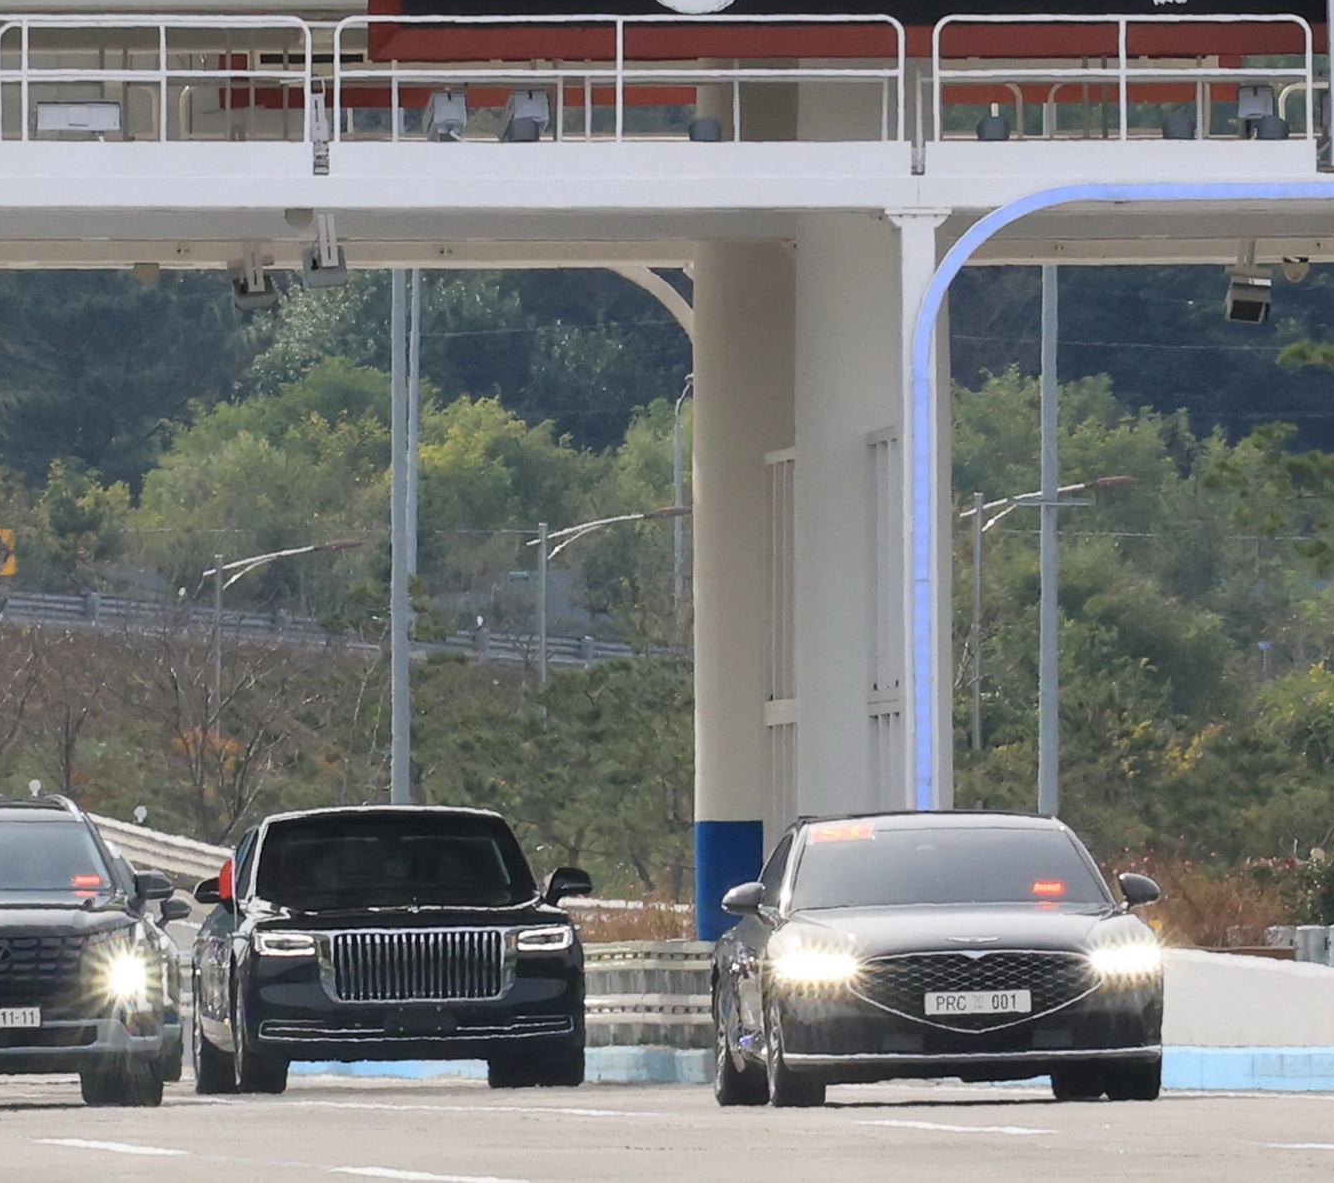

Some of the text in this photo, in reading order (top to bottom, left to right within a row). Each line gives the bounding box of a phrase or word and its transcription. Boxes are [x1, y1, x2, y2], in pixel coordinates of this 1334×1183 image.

[935, 994, 1017, 1011] PRC 001
[0, 1010, 35, 1026] 11-11
